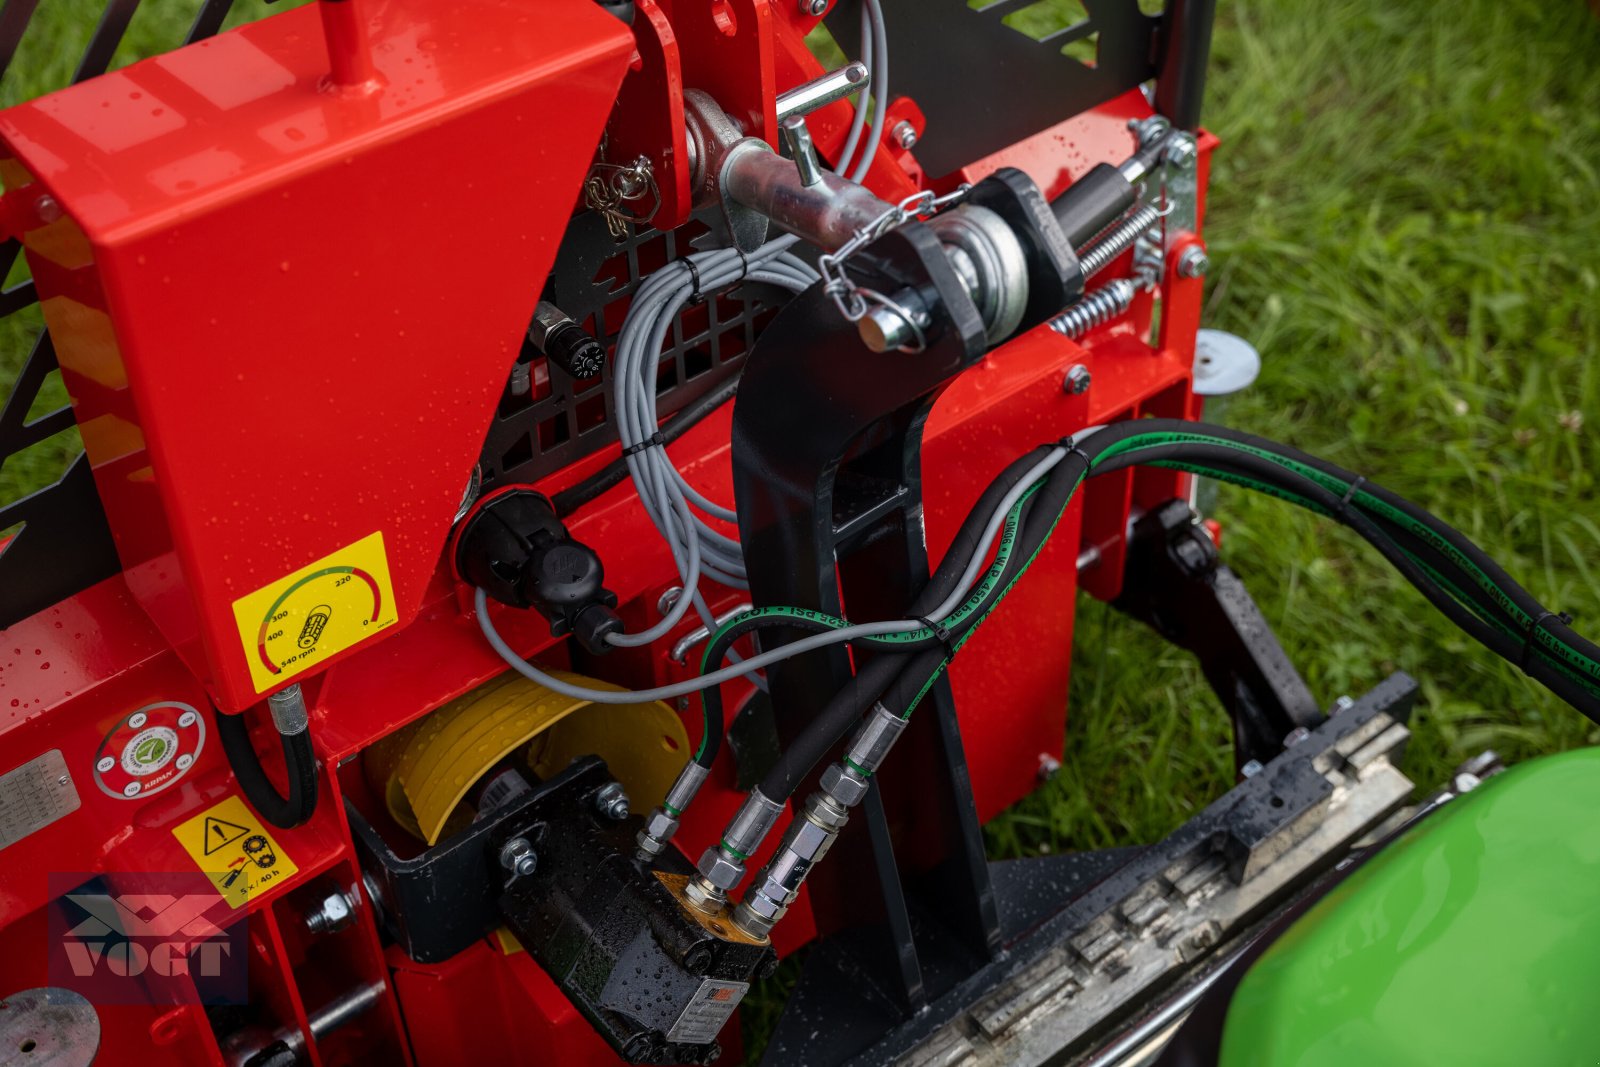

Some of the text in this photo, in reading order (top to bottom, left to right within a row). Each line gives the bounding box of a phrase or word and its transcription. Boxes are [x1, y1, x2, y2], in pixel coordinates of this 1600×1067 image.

[335, 575, 352, 587] 220
[970, 582, 991, 605] 450
[272, 610, 289, 623] 300
[790, 607, 816, 619] PSI
[951, 604, 972, 622] bar
[1489, 587, 1510, 611] DN12
[1536, 627, 1551, 646] 345
[1553, 641, 1571, 660] bar
[267, 629, 284, 642] 400
[904, 630, 929, 642] 1/4"
[281, 647, 316, 669] 540 rpm
[100, 760, 112, 769] 322
[144, 770, 173, 789] KRPAN
[260, 873, 273, 883] 40
[271, 869, 280, 877] h
